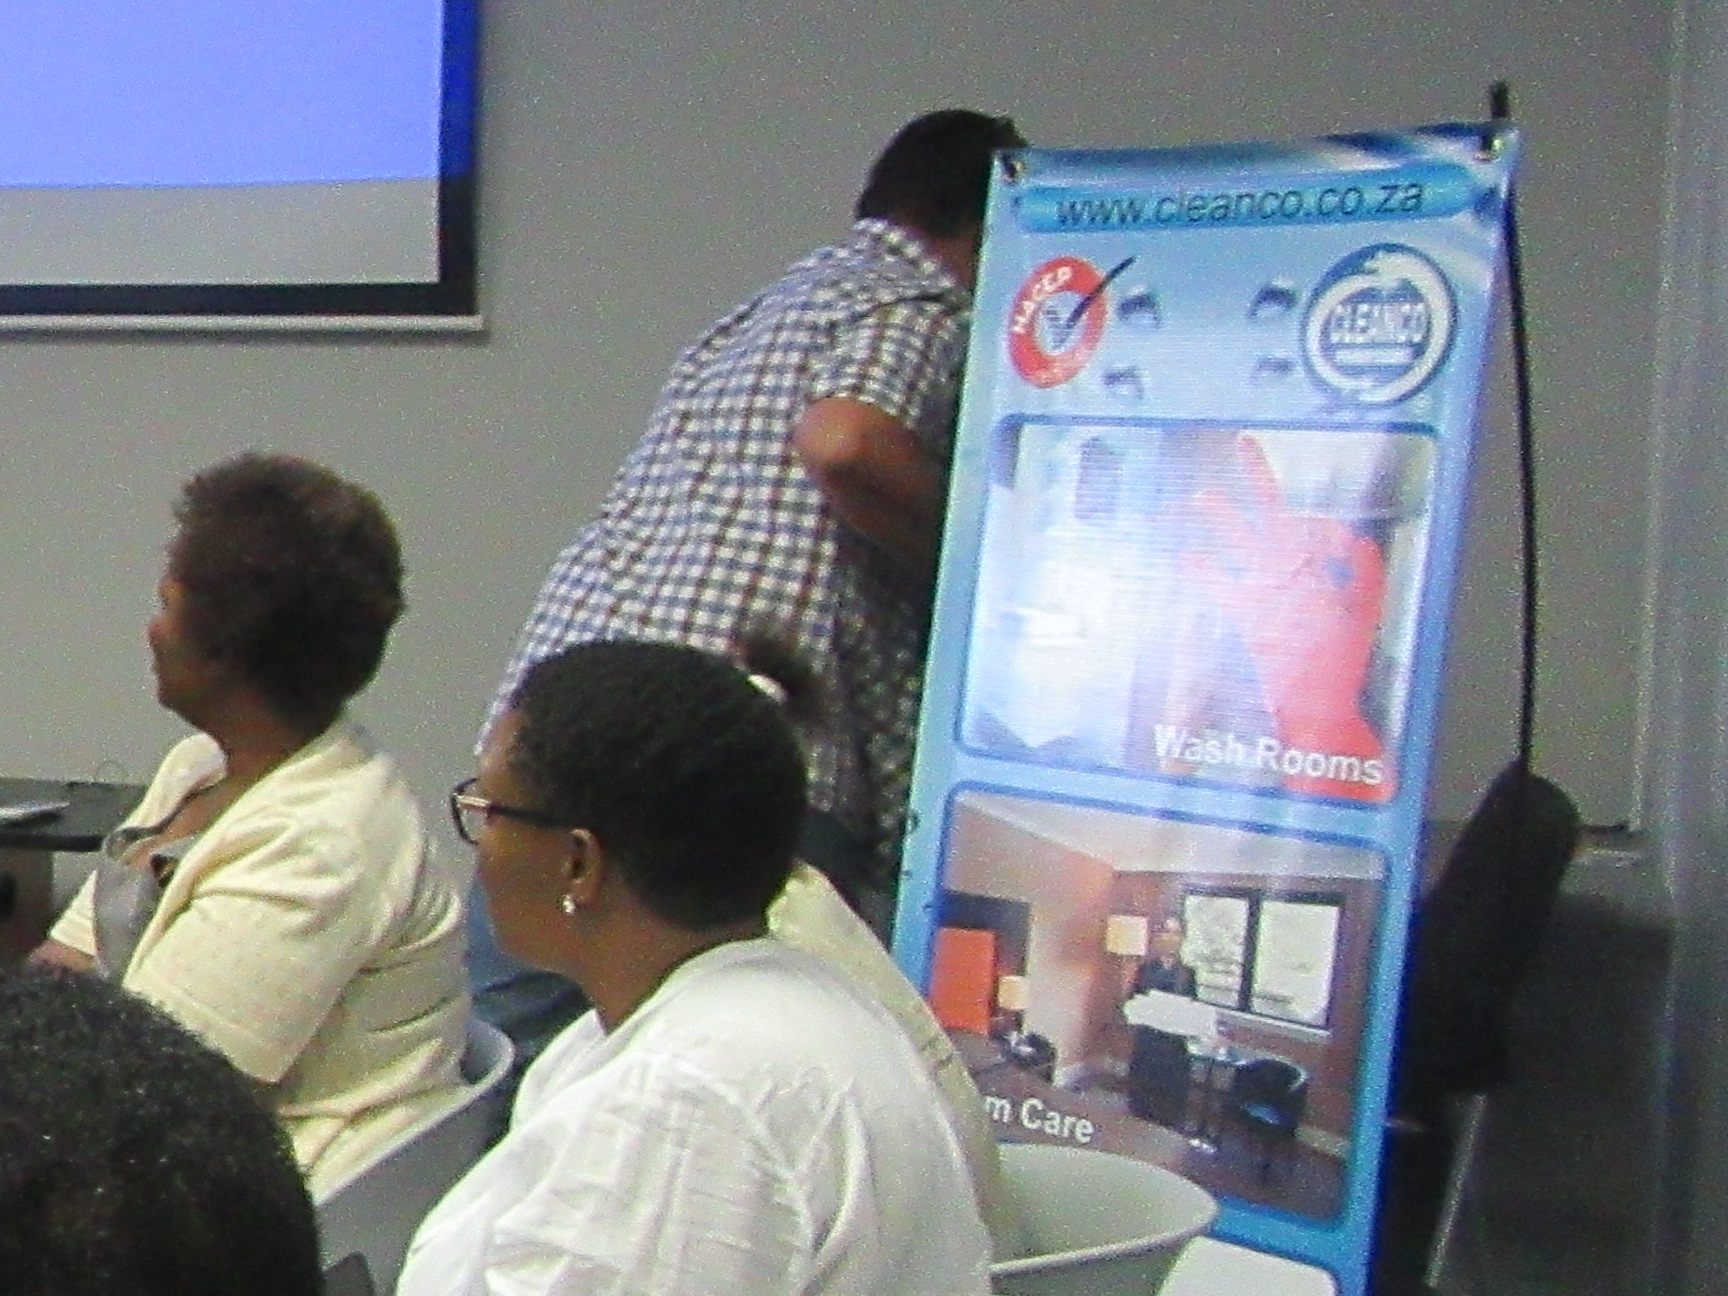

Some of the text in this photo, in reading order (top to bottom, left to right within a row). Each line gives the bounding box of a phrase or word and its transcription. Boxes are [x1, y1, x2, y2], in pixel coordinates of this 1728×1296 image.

[1056, 181, 1425, 226] www.cleanco.co.za
[1152, 725, 1384, 786] Wash Rooms
[1020, 1097, 1095, 1144] Care
